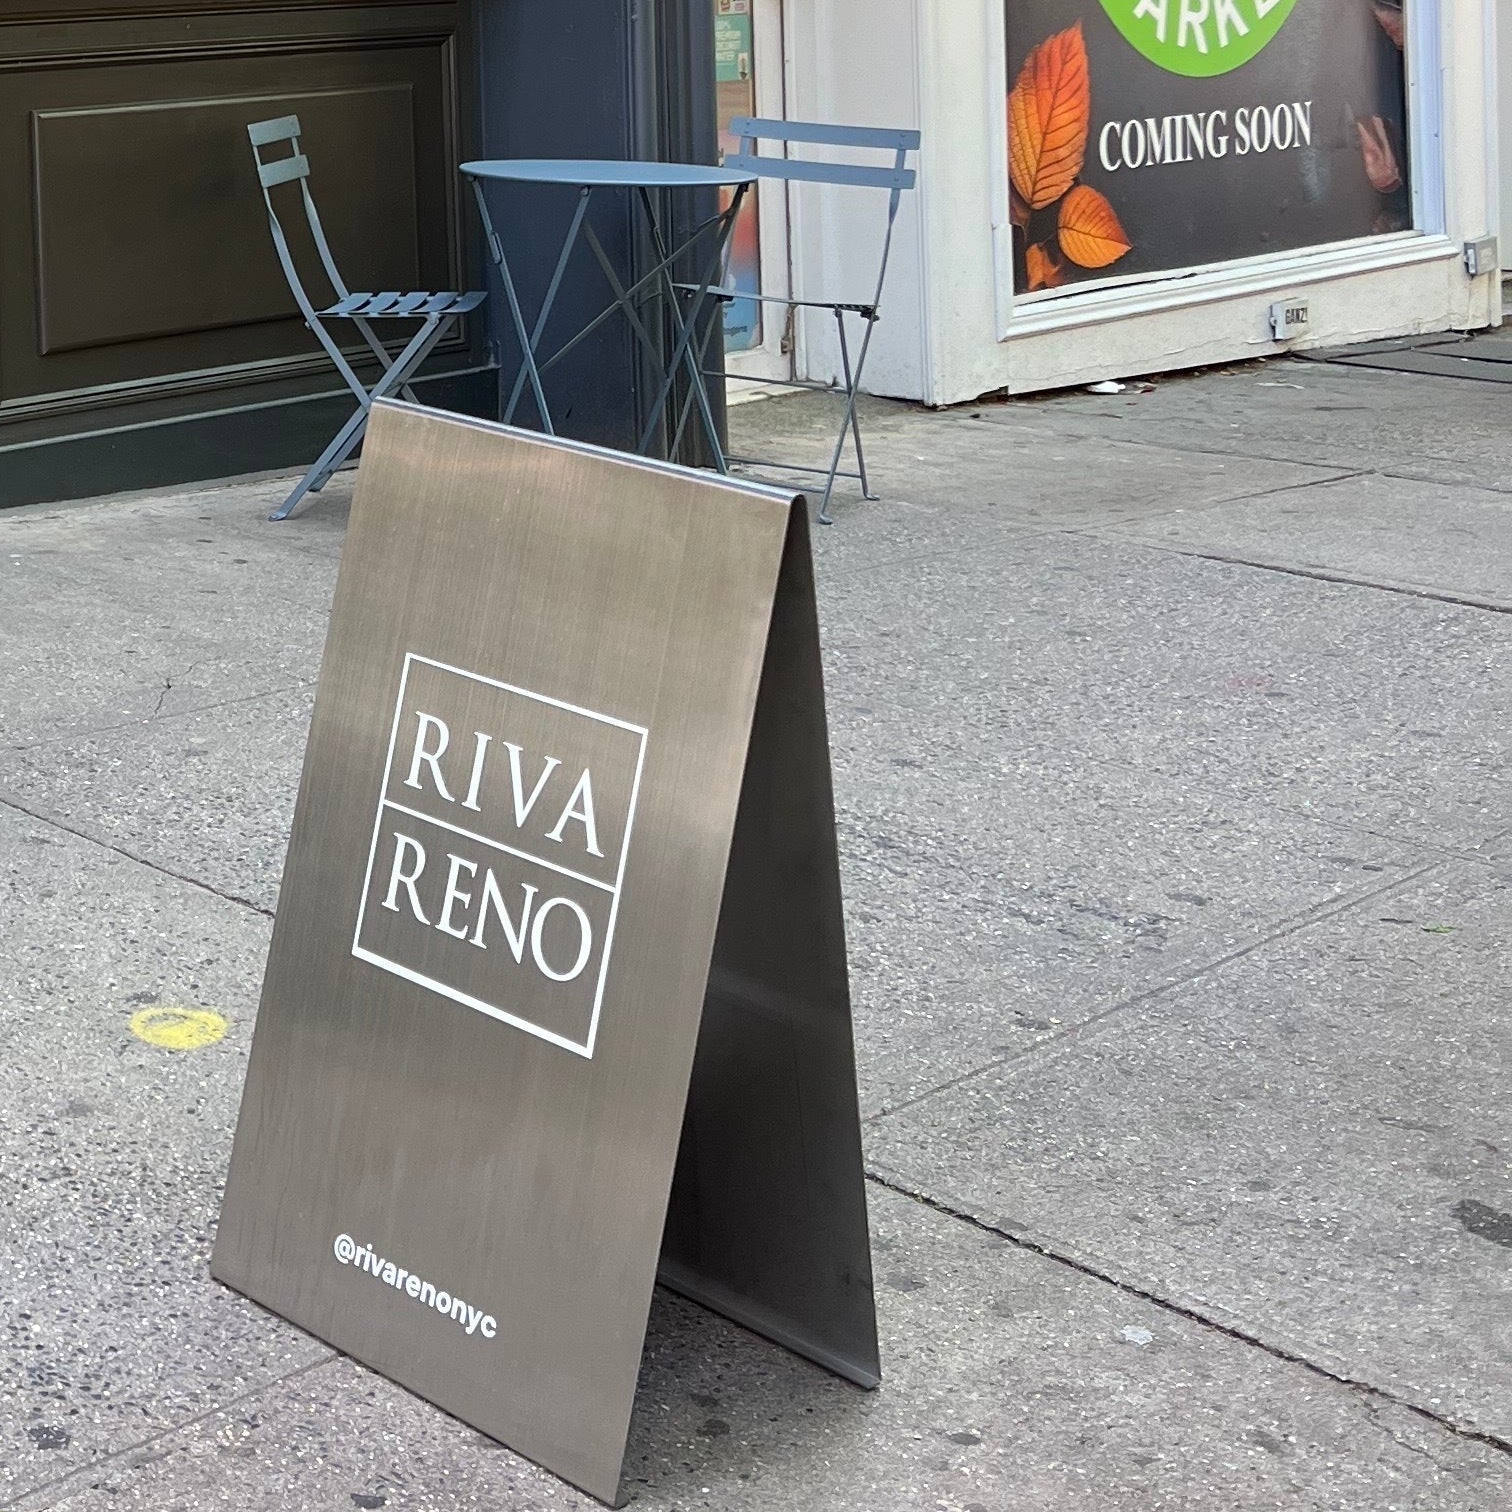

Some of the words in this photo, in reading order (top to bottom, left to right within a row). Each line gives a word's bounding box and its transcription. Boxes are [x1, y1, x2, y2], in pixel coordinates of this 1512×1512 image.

[1099, 110, 1228, 172] COMING
[1235, 100, 1312, 156] SOON
[403, 710, 605, 857] RIVA
[381, 831, 592, 982] RENO
[334, 1234, 497, 1338] @rivarenonyc
